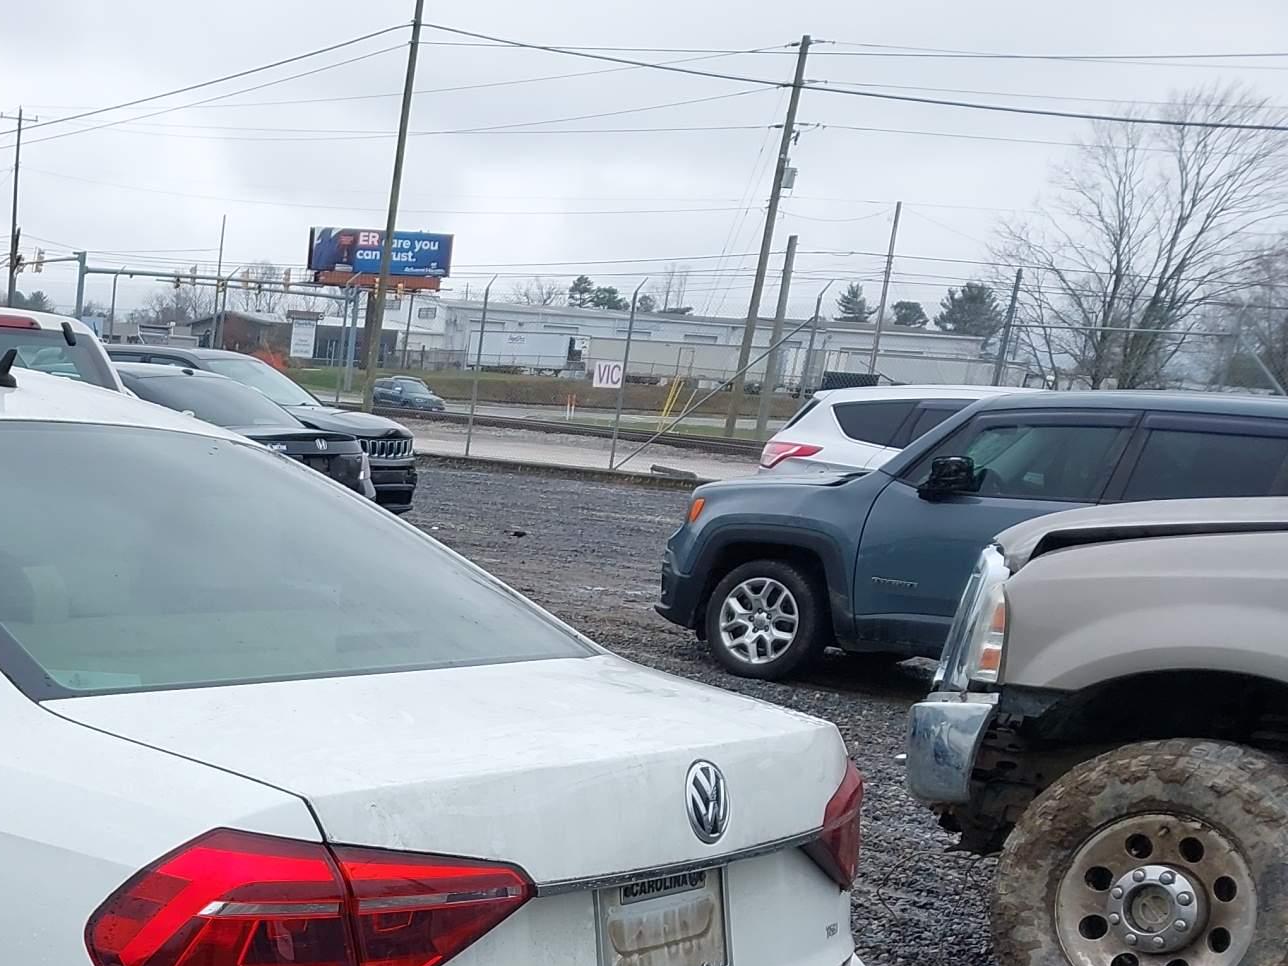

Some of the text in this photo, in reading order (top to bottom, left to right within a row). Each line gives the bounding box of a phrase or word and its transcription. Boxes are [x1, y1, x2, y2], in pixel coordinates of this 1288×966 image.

[358, 232, 379, 246] ER
[414, 239, 439, 251] you
[356, 249, 380, 260] can
[598, 363, 621, 385] VIC
